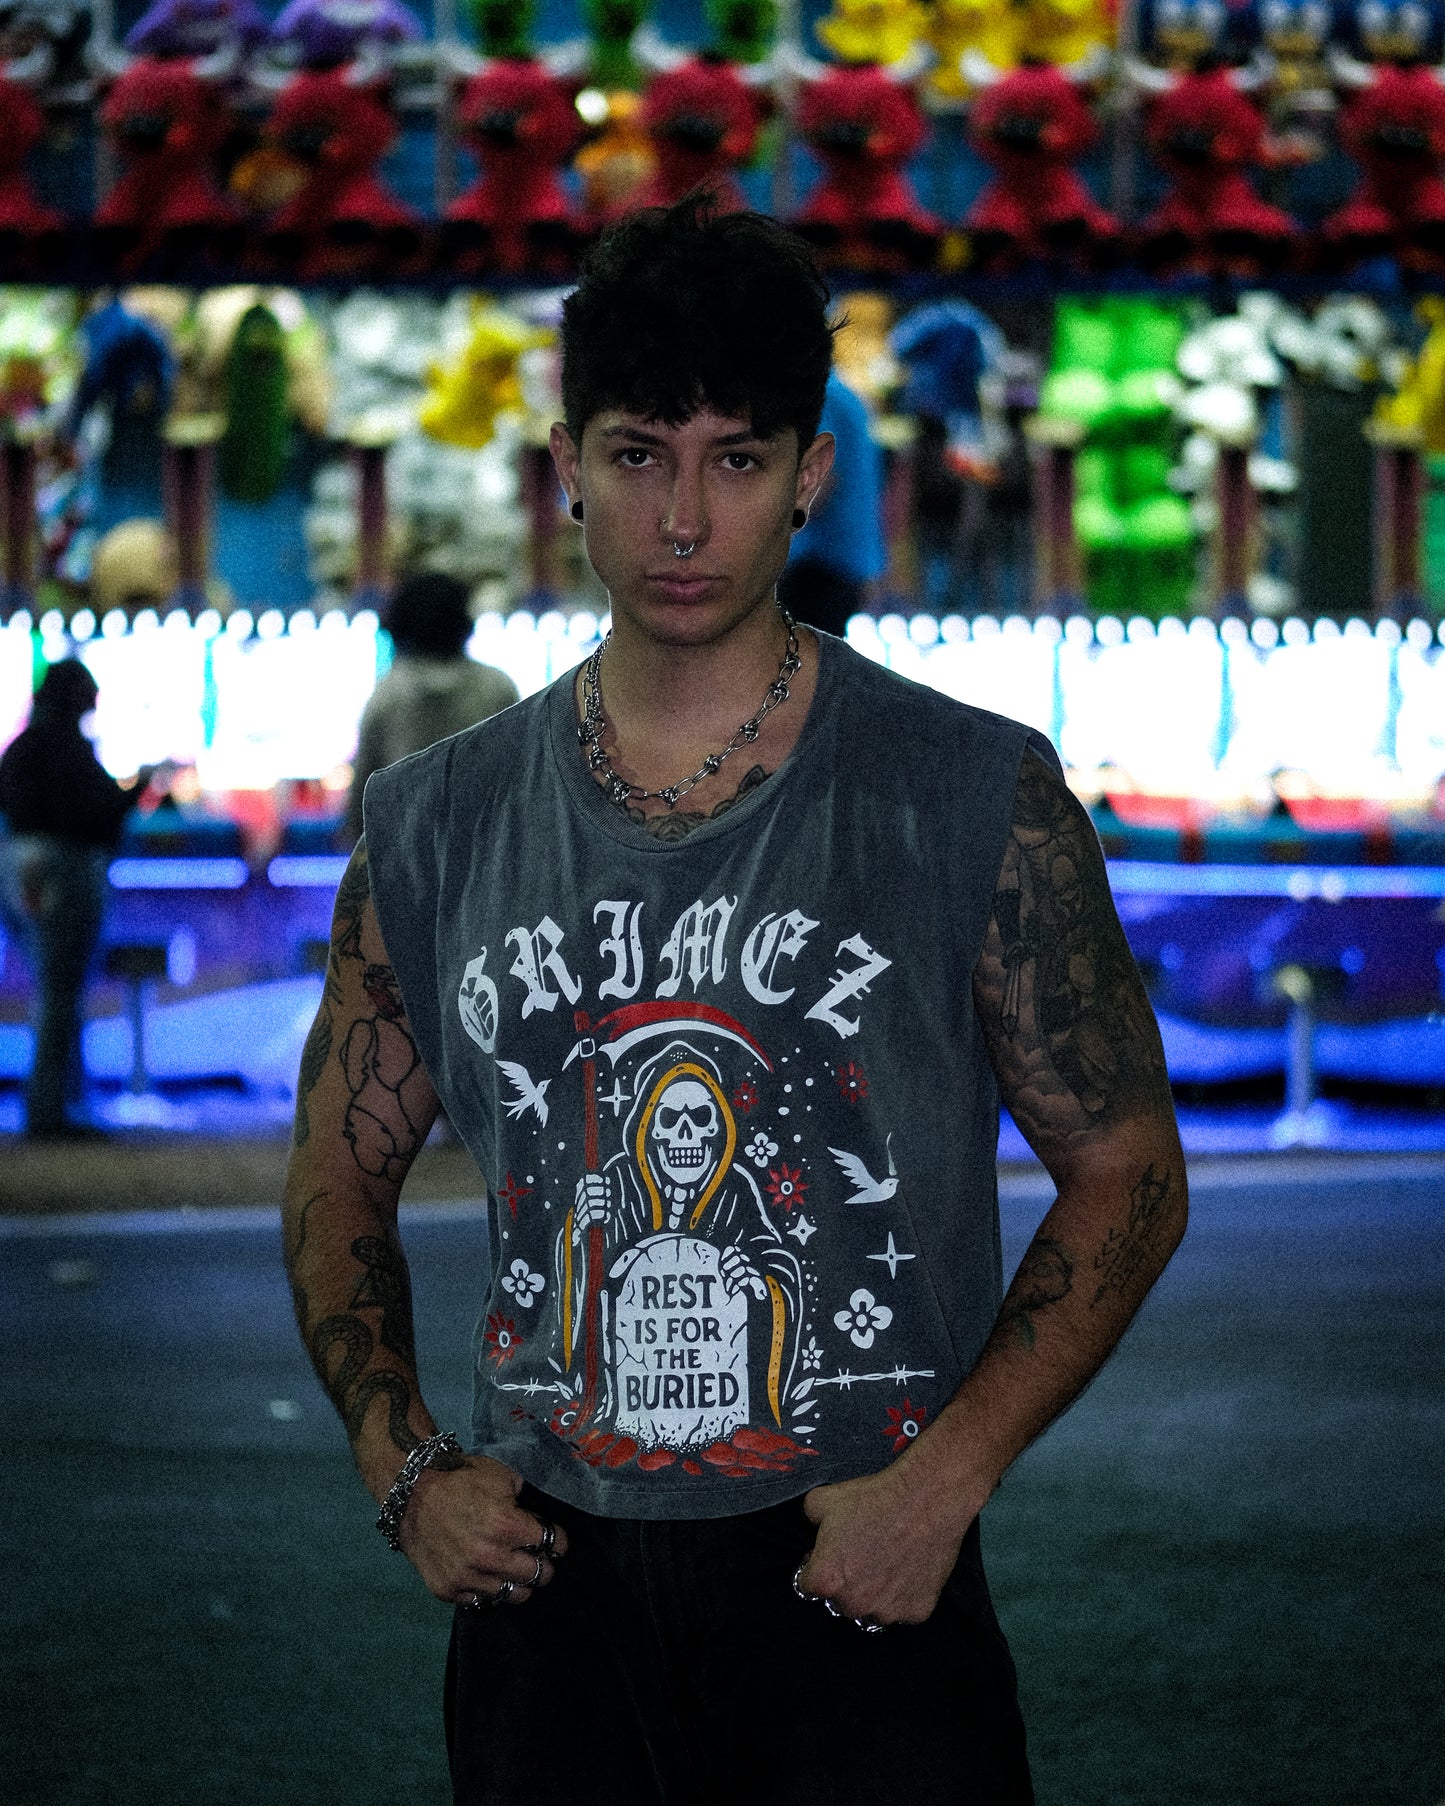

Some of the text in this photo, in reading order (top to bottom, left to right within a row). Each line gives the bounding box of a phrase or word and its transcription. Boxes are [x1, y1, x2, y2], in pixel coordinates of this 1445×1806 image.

[641, 1273, 717, 1310] REST
[634, 1316, 723, 1345] IS FOR
[653, 1348, 702, 1369] THE
[625, 1372, 740, 1412] BURIED
